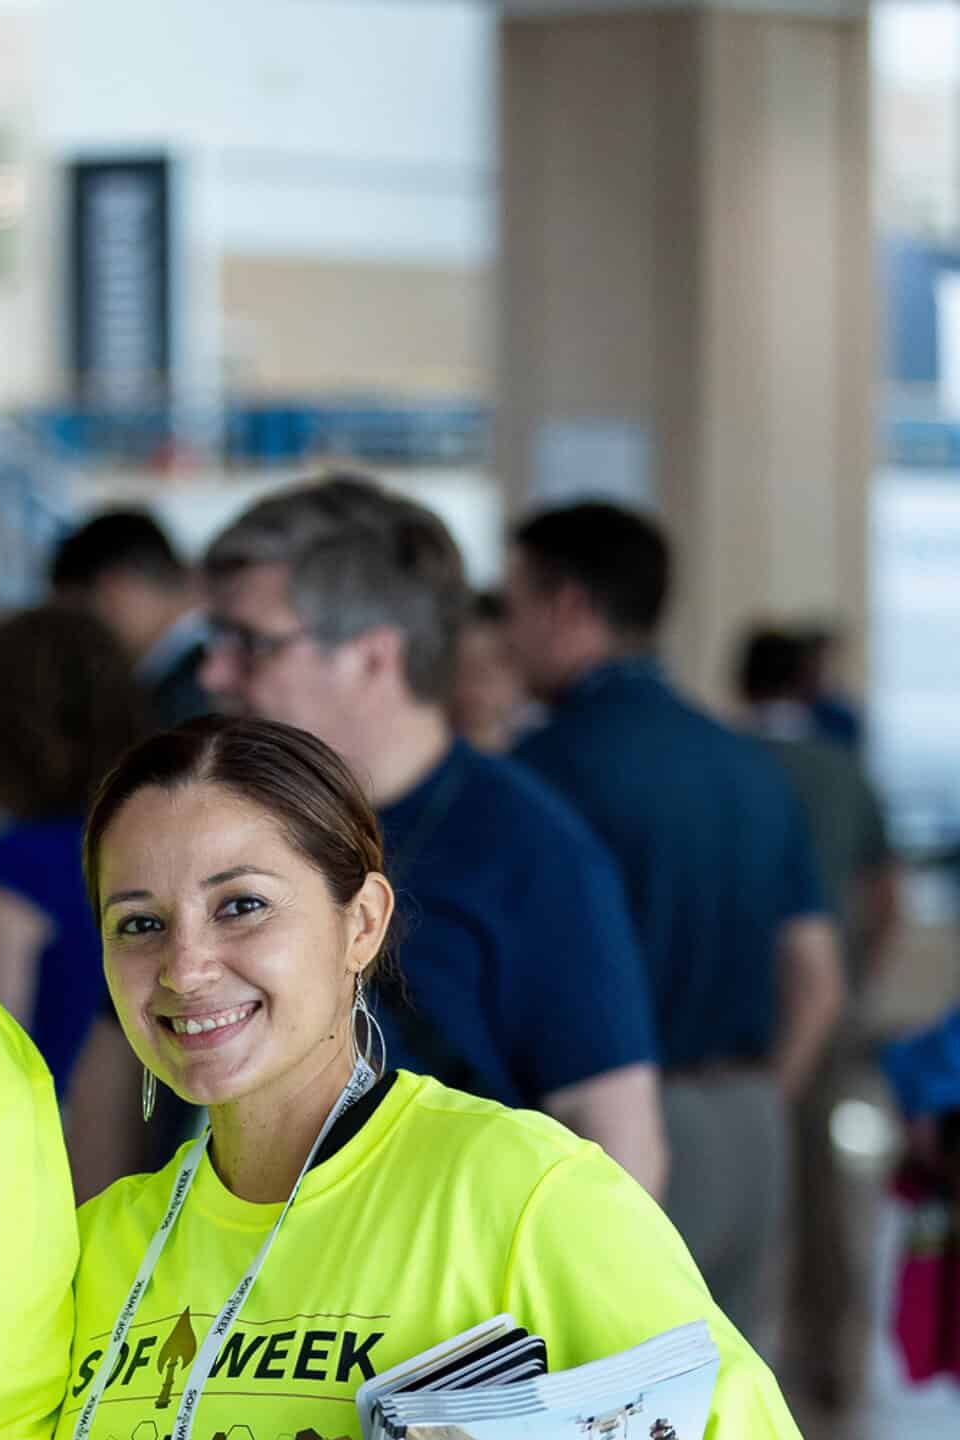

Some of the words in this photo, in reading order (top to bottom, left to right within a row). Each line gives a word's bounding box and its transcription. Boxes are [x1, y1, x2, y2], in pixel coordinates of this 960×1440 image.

[208, 1330, 385, 1383] WEEK
[81, 1394, 98, 1425] WEEK
[185, 1389, 197, 1415] SOF
